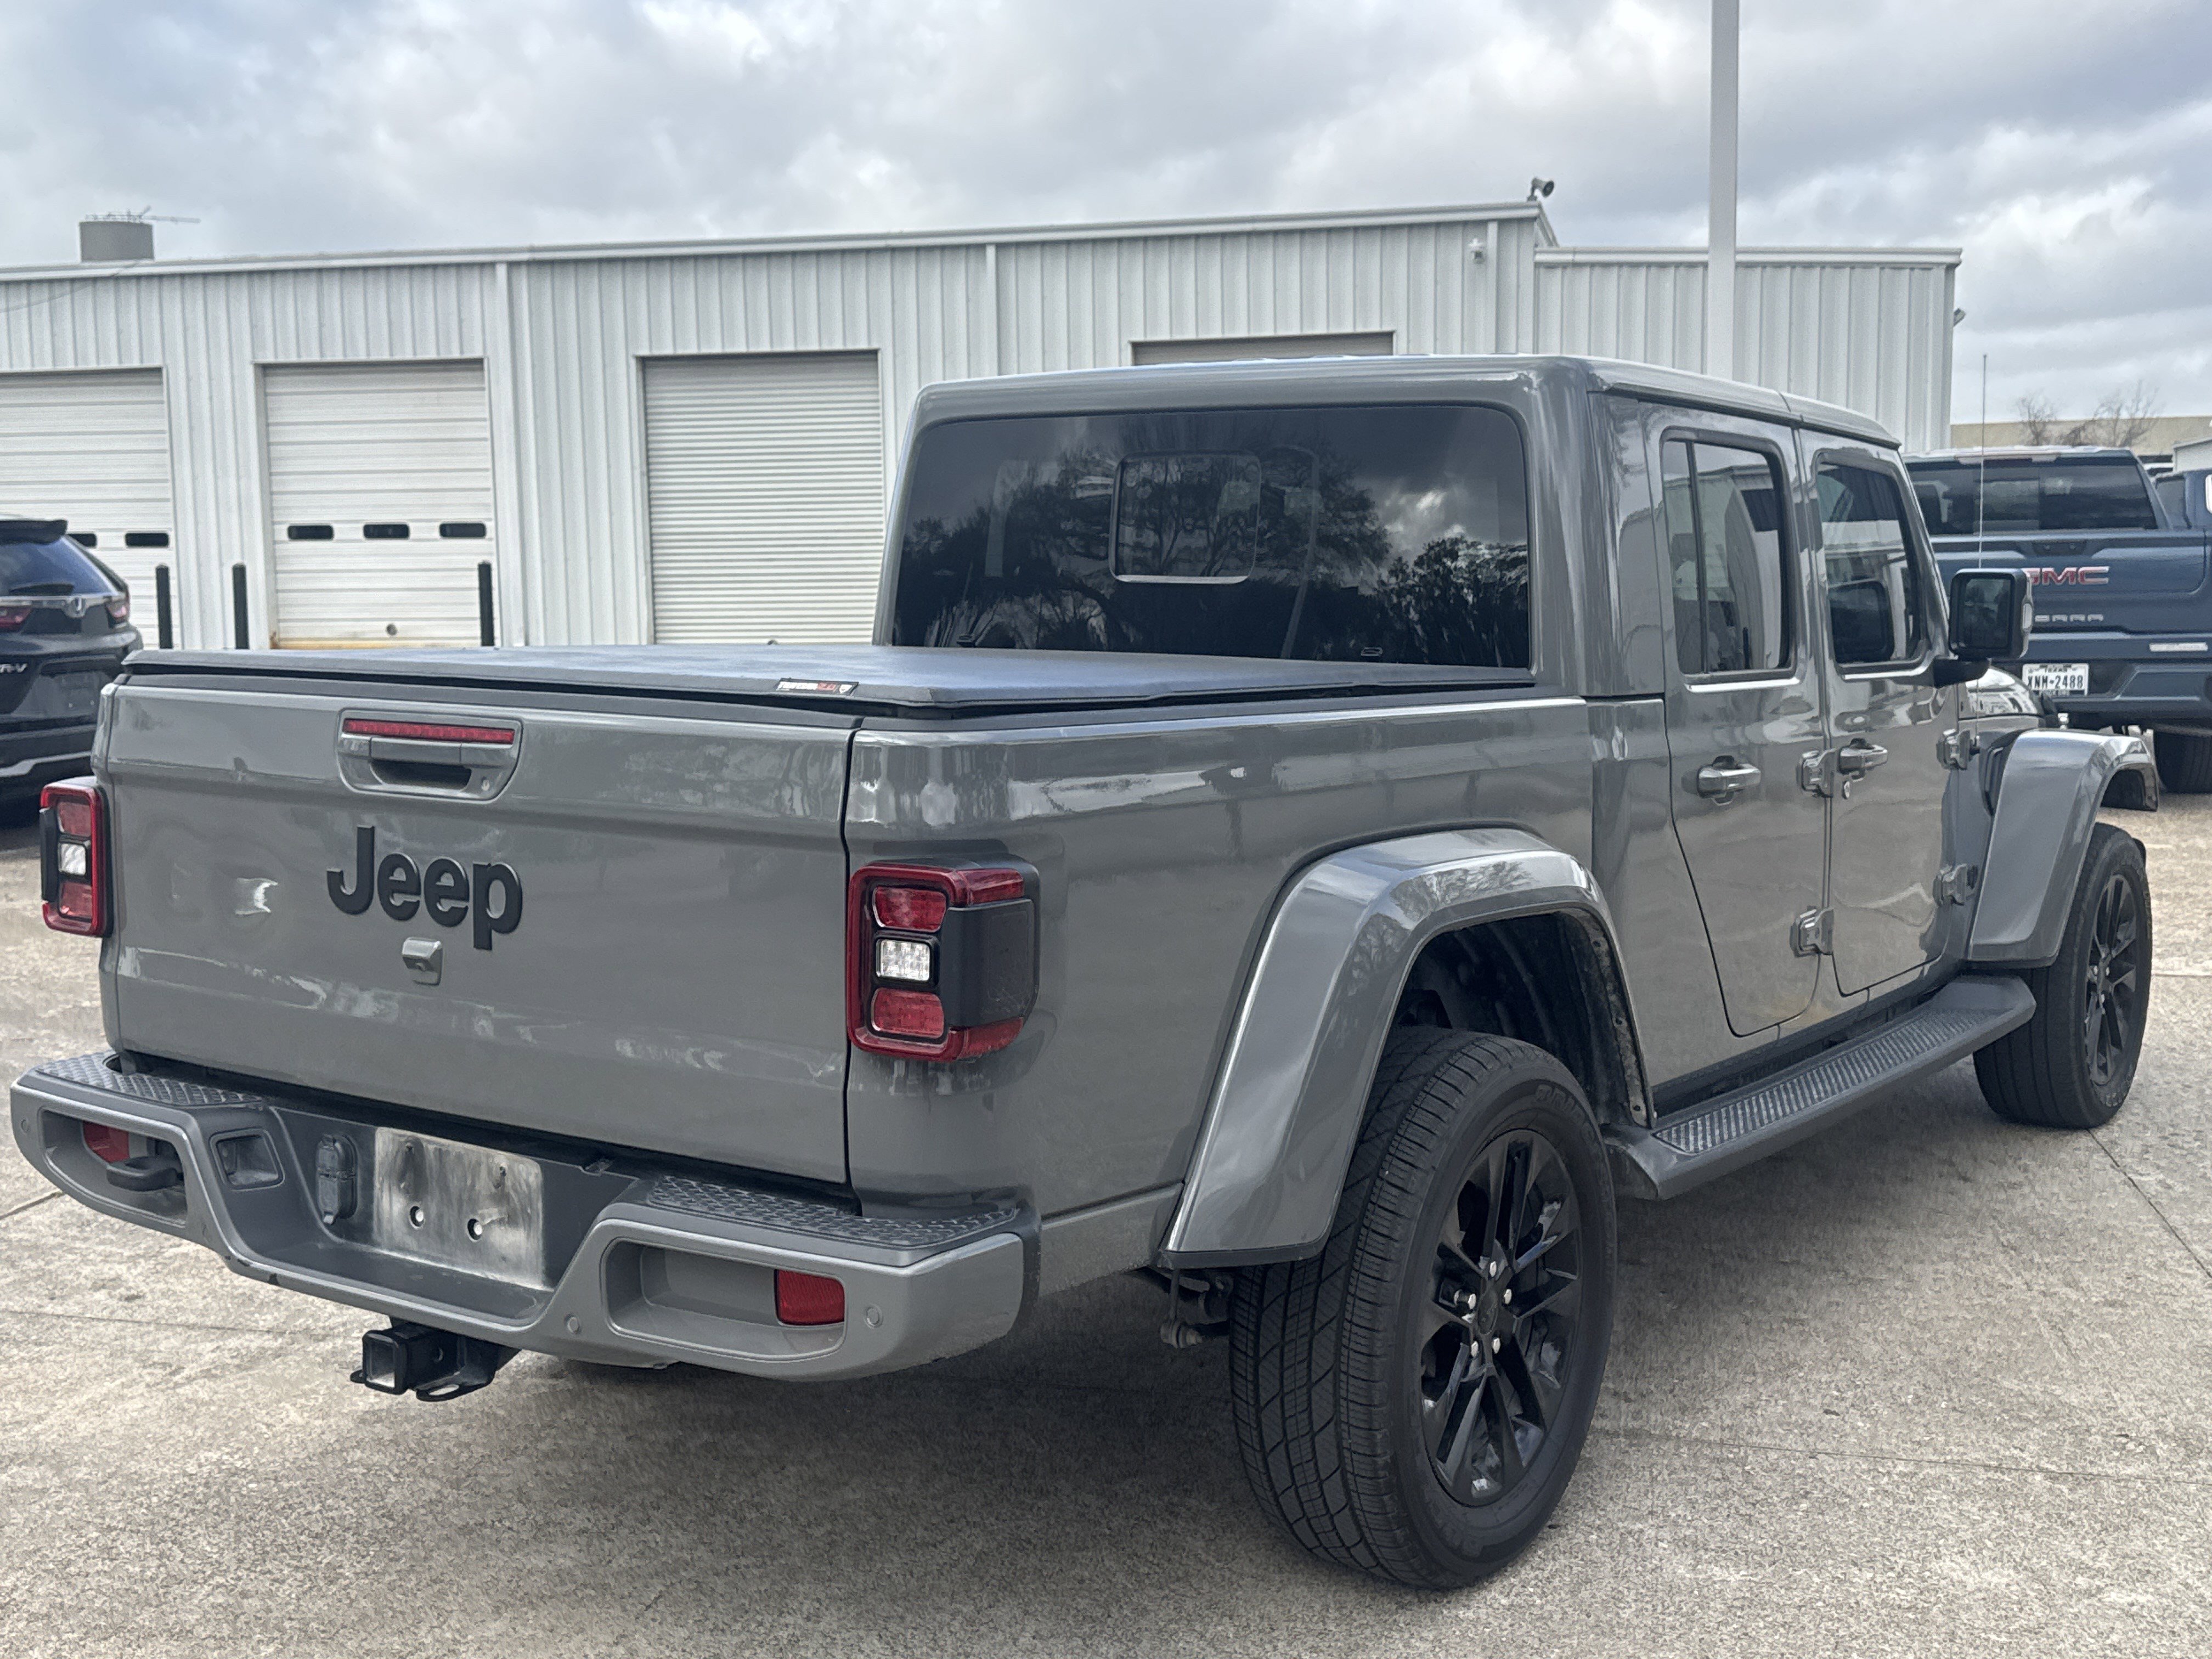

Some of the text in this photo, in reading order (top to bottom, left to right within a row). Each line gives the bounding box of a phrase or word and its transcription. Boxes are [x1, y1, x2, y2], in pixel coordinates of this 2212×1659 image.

[2034, 614, 2104, 622] ERRA
[0, 663, 28, 673] R-V
[327, 824, 523, 950] Jeep
